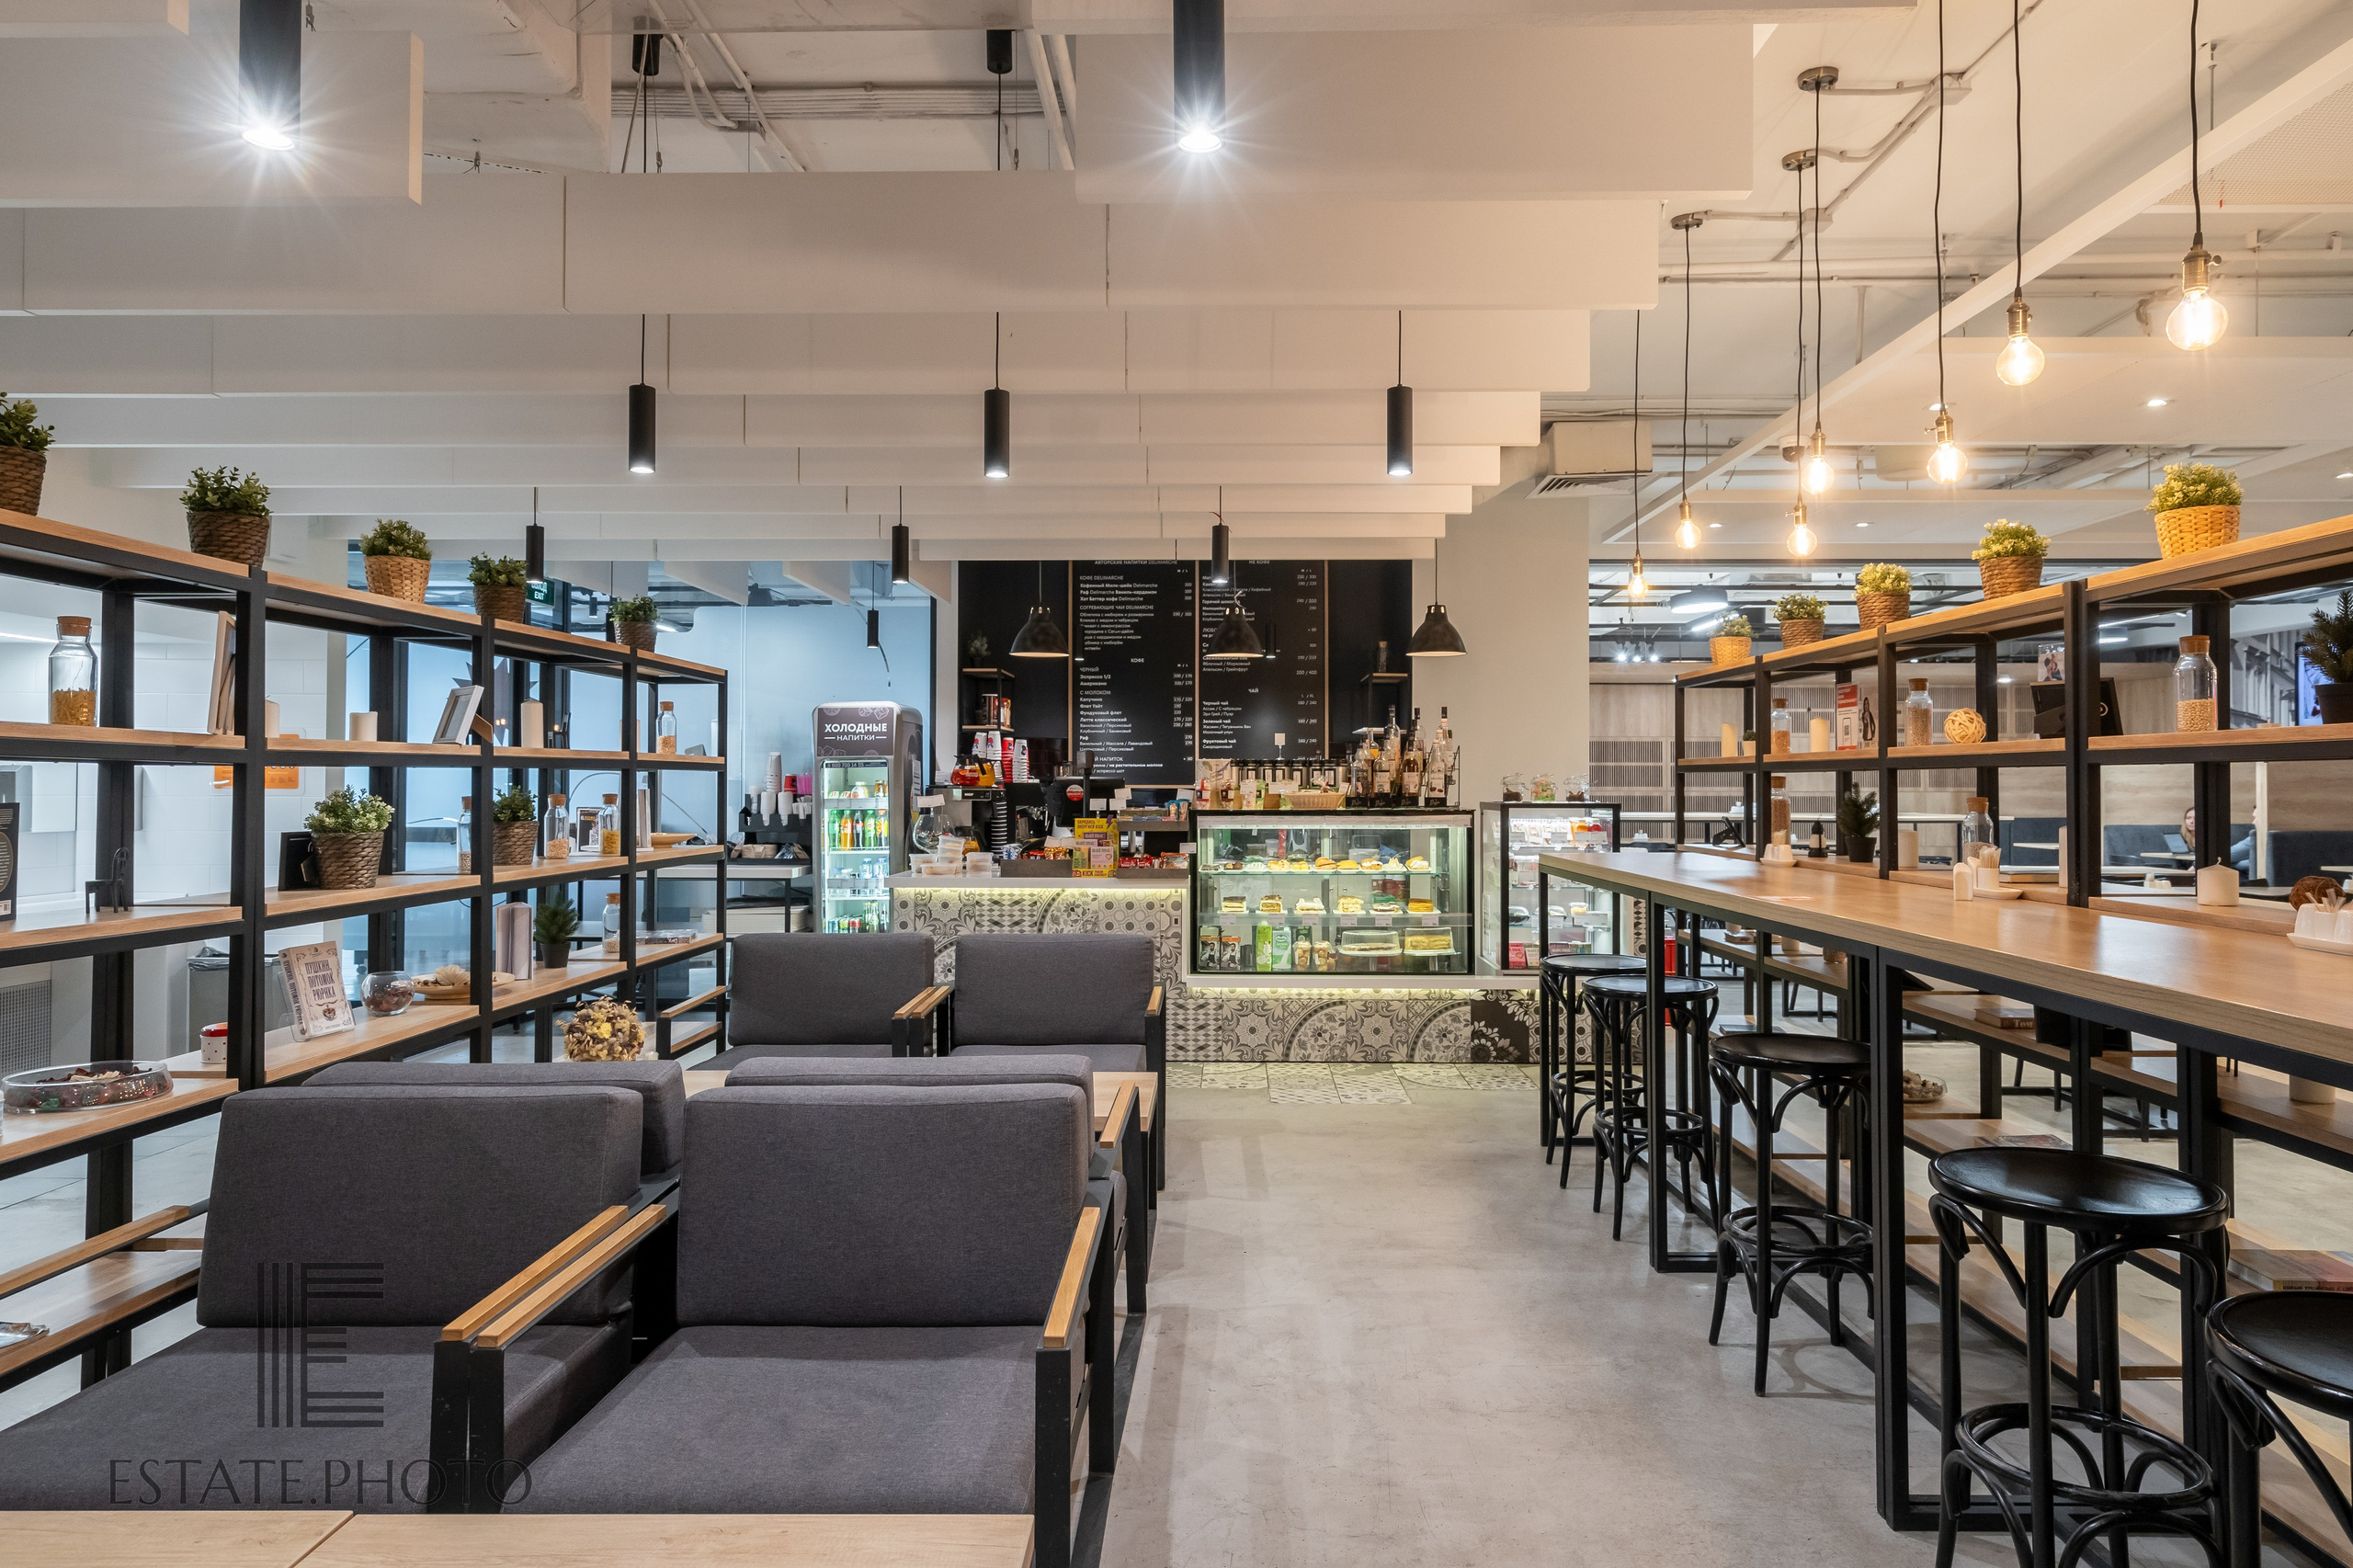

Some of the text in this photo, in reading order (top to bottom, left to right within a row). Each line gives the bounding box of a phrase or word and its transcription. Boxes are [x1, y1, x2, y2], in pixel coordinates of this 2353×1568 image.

[534, 591, 545, 601] EXIT
[824, 723, 888, 733] ХОЛОДНЫЕ
[305, 960, 332, 974] ПУШКИН,
[283, 960, 293, 983] ПУШКИН,
[289, 982, 300, 1004] ПОТОМОК
[308, 972, 335, 988] ПОТОМОК
[312, 986, 336, 1001] РЮРИКА
